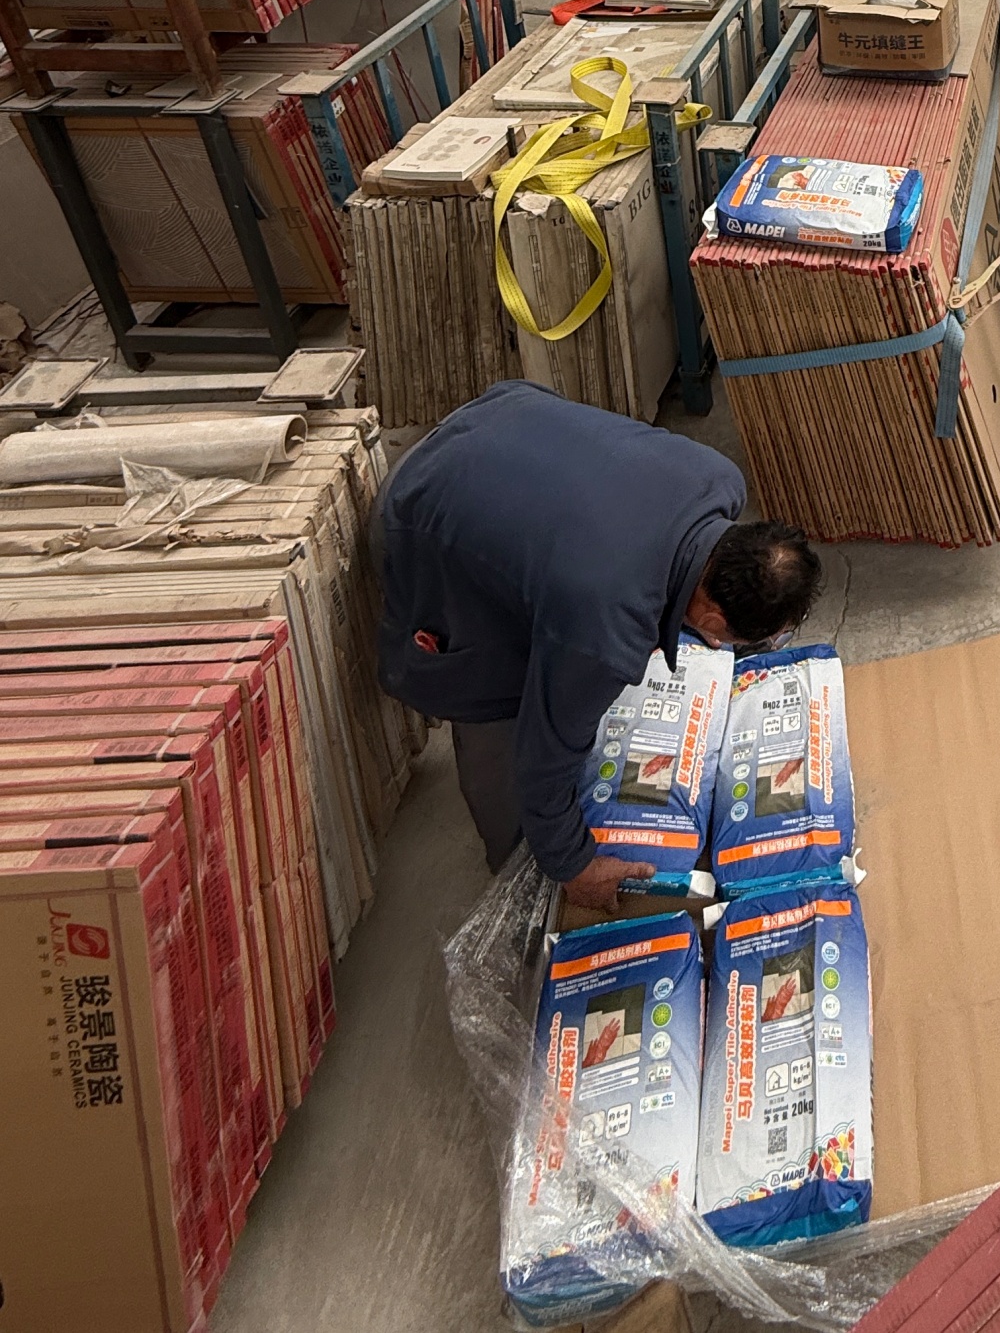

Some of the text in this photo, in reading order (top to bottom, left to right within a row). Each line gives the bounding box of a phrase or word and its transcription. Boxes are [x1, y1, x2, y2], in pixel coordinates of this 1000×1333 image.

[838, 32, 925, 51] 牛元填缝王
[627, 178, 651, 223] BIG
[743, 222, 785, 238] MAPEI
[862, 240, 882, 248] 20kg
[647, 678, 666, 692] 20kg
[762, 700, 781, 710] 20kg
[590, 940, 652, 967] 马贝胶粘剂系列
[59, 975, 88, 1109] JUNJING CERAMICS
[75, 975, 124, 1107] 骏景陶瓷
[547, 1012, 562, 1077] Adhesive
[722, 970, 739, 1153] Mapei Super Tile Adhesive
[738, 987, 757, 1119] 马贝高效胶粘剂
[791, 1099, 814, 1118] 20kg
[781, 1167, 806, 1183] MAPEI
